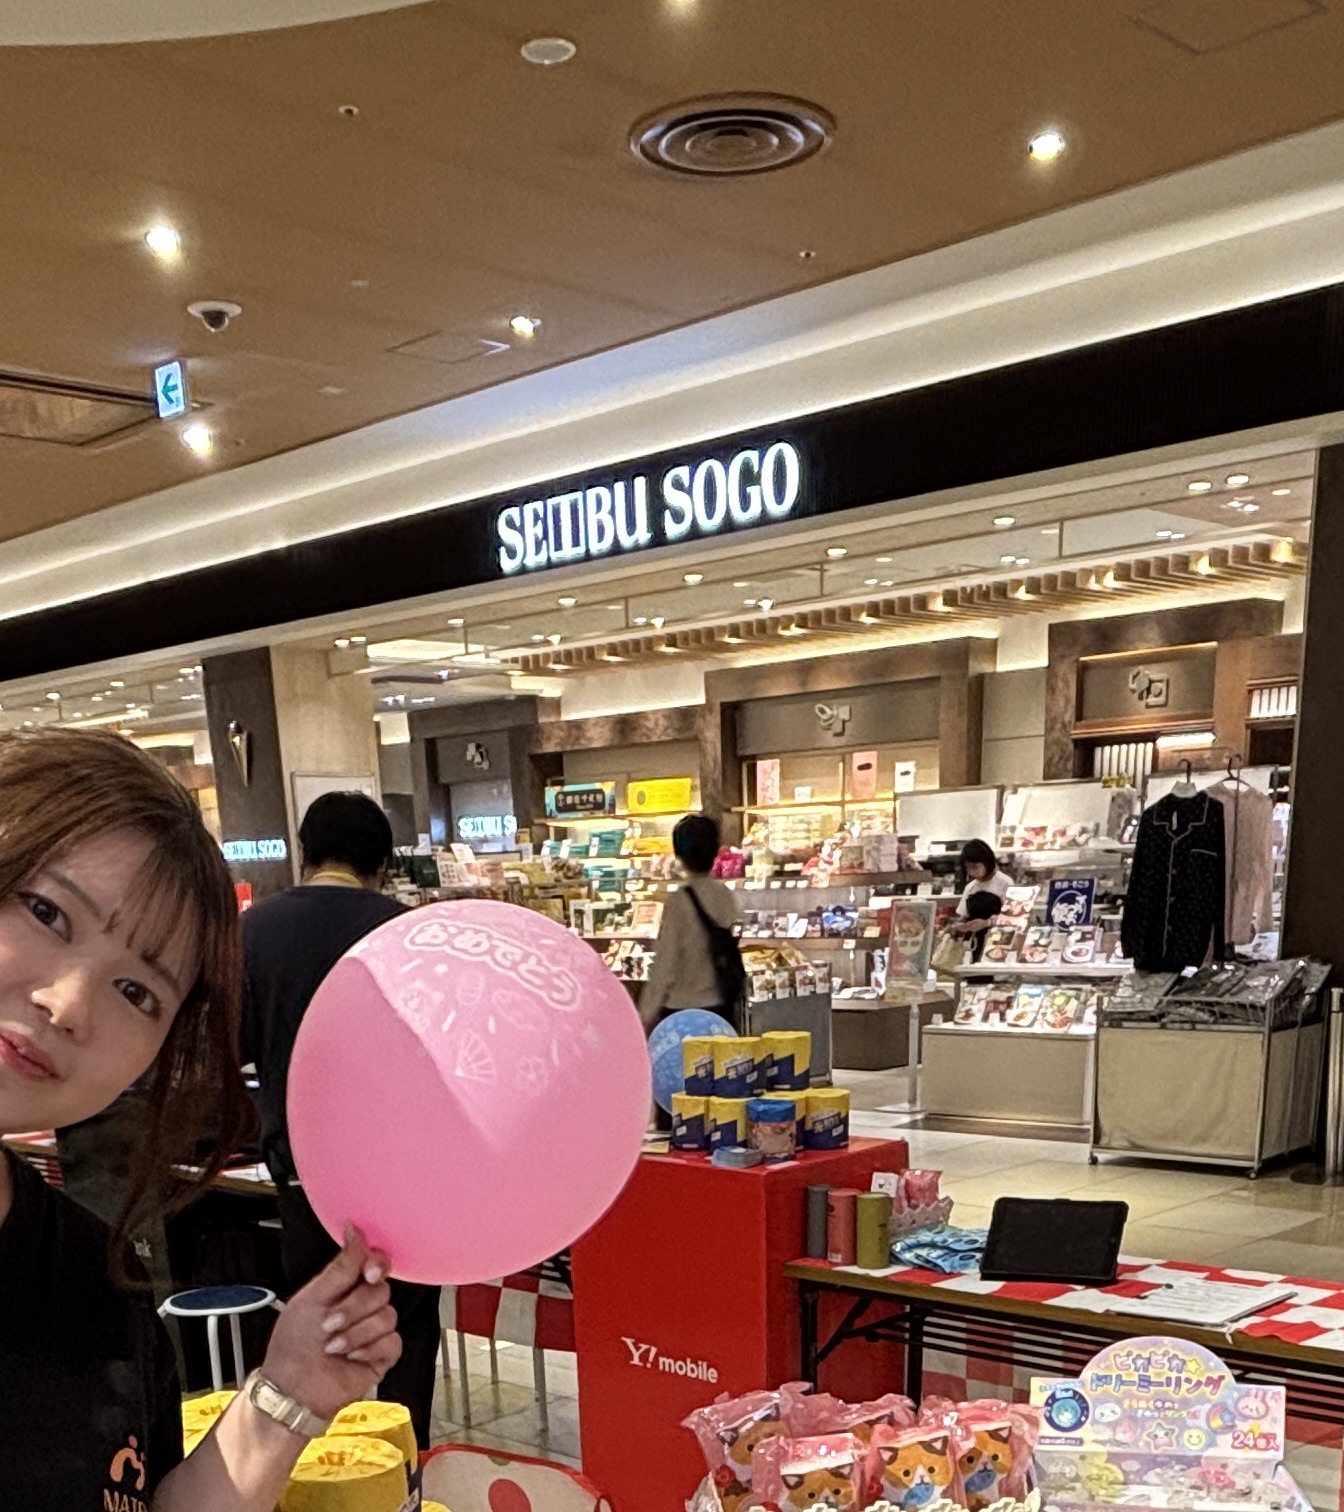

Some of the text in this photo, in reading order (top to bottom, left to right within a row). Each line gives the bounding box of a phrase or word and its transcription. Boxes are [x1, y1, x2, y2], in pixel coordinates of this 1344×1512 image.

[498, 441, 800, 574] SEIBU SOGO
[408, 921, 579, 1005] おめでとう
[621, 1336, 719, 1384] Y! mobile
[1113, 1350, 1187, 1376] ピカピカ
[1090, 1373, 1226, 1396] ドリーミーリング
